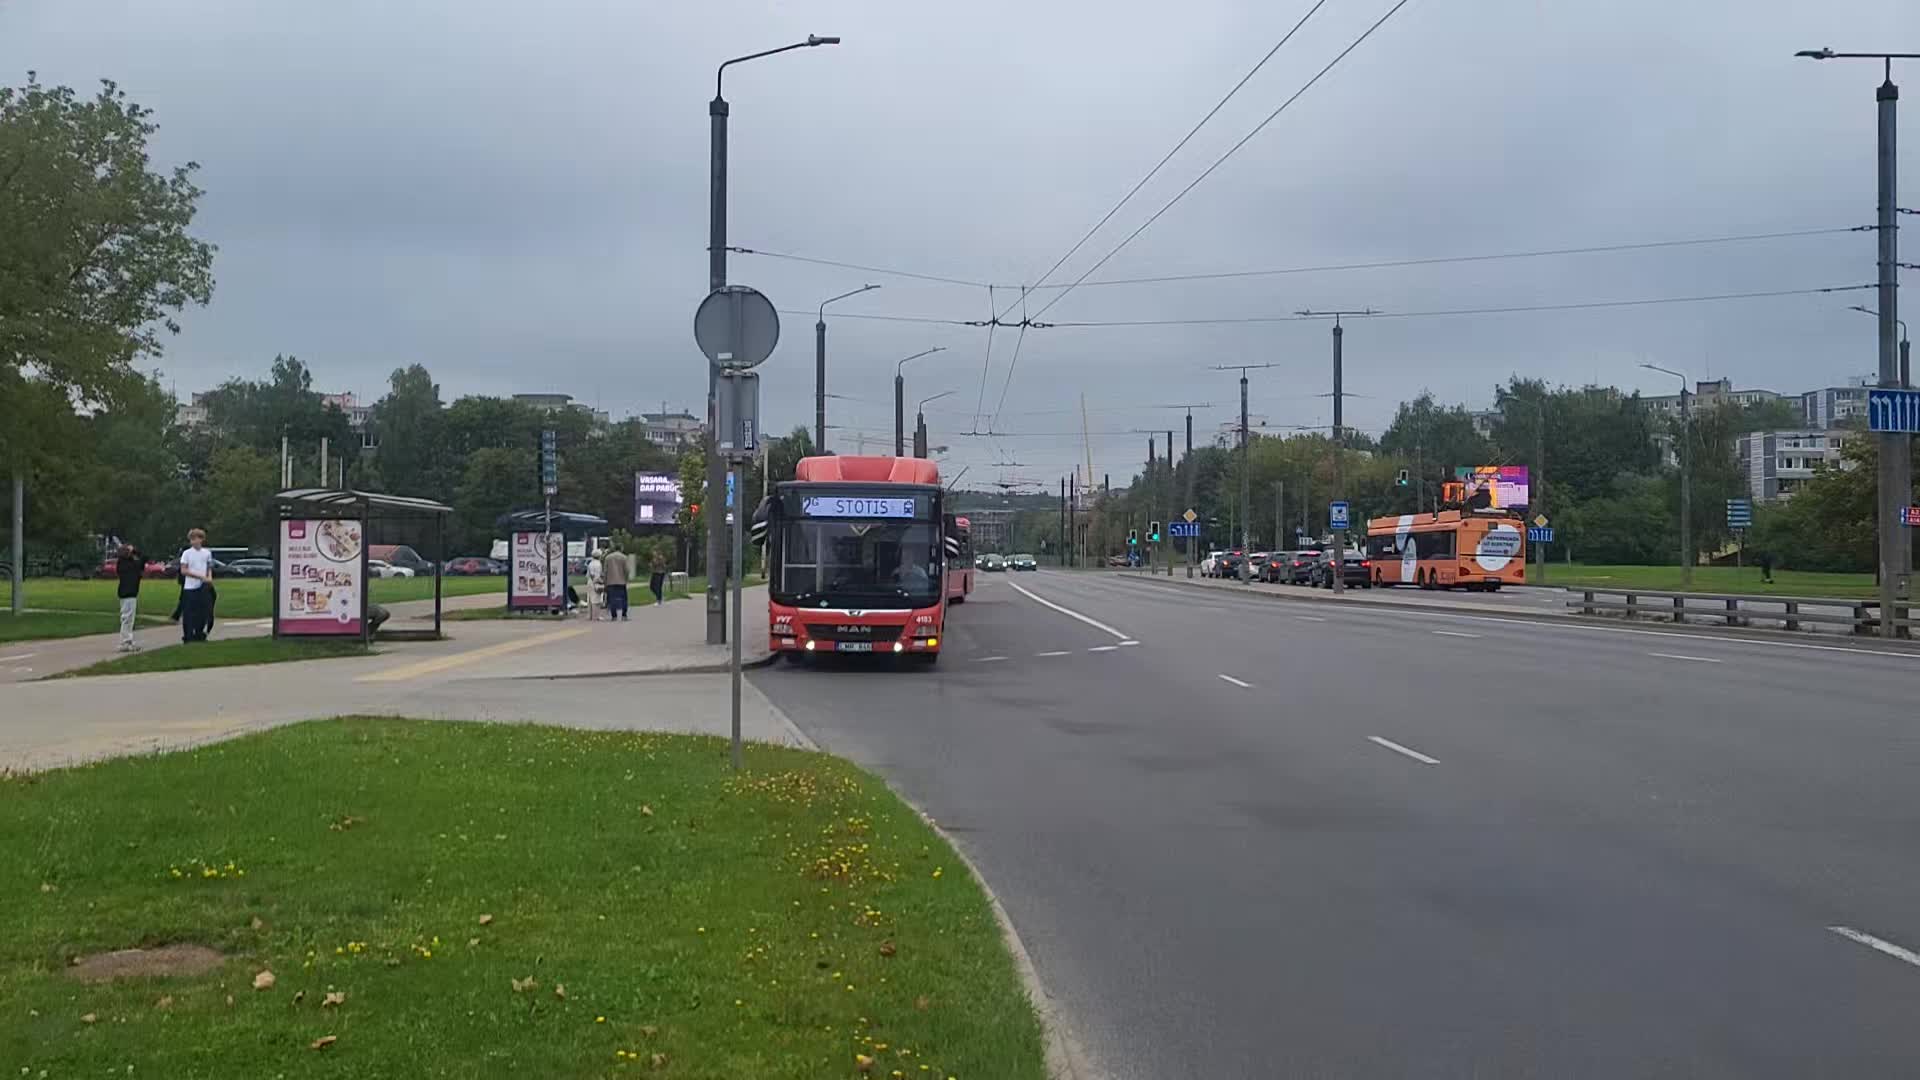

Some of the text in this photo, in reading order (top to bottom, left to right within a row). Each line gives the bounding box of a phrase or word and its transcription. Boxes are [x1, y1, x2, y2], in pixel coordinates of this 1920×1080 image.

[640, 476, 670, 484] VASARA,
[640, 484, 655, 492] DAR
[836, 499, 889, 514] STOTIS
[837, 625, 872, 633] MAN
